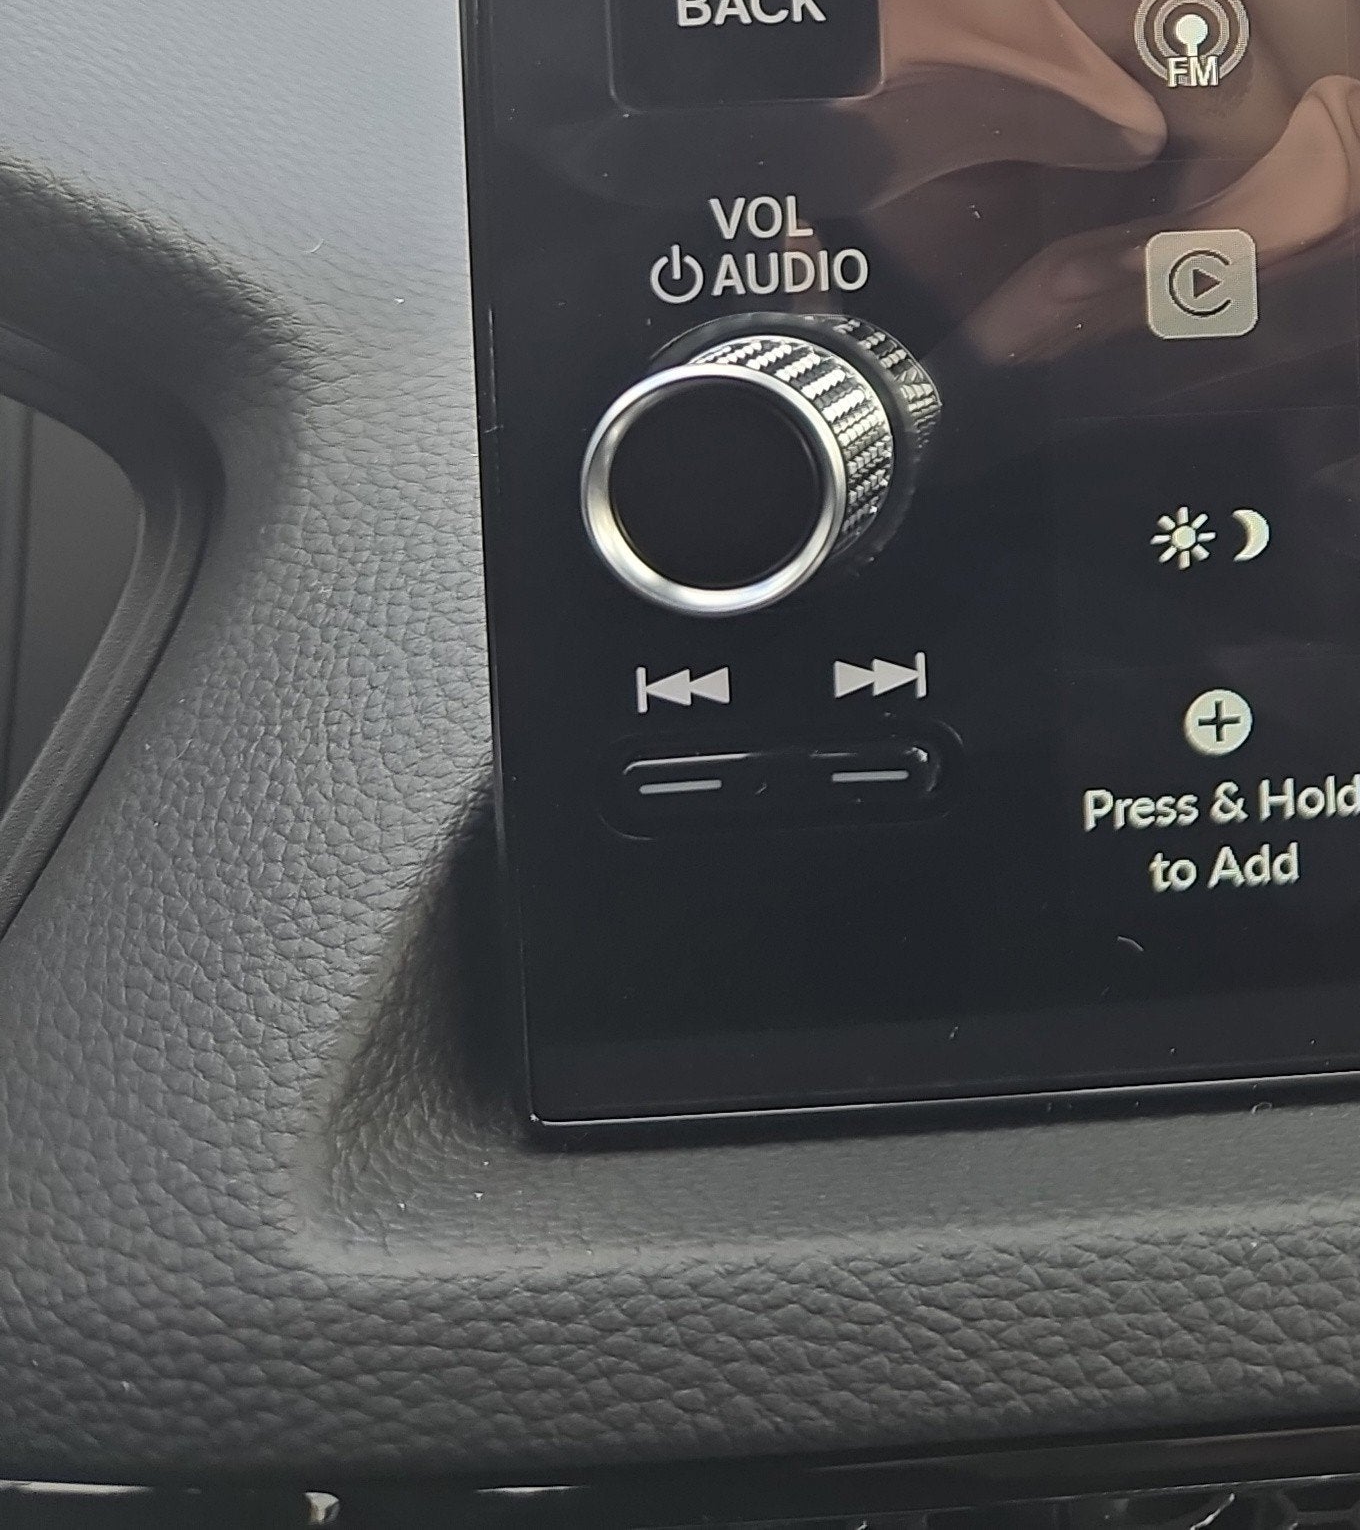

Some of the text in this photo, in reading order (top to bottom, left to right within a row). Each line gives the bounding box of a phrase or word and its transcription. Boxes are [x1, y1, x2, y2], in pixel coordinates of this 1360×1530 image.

[1166, 56, 1220, 88] FM
[709, 194, 814, 241] VOL
[711, 247, 870, 297] AUDIO
[1082, 786, 1200, 834] Press
[1210, 782, 1249, 823] &
[1149, 842, 1301, 894] to Add
